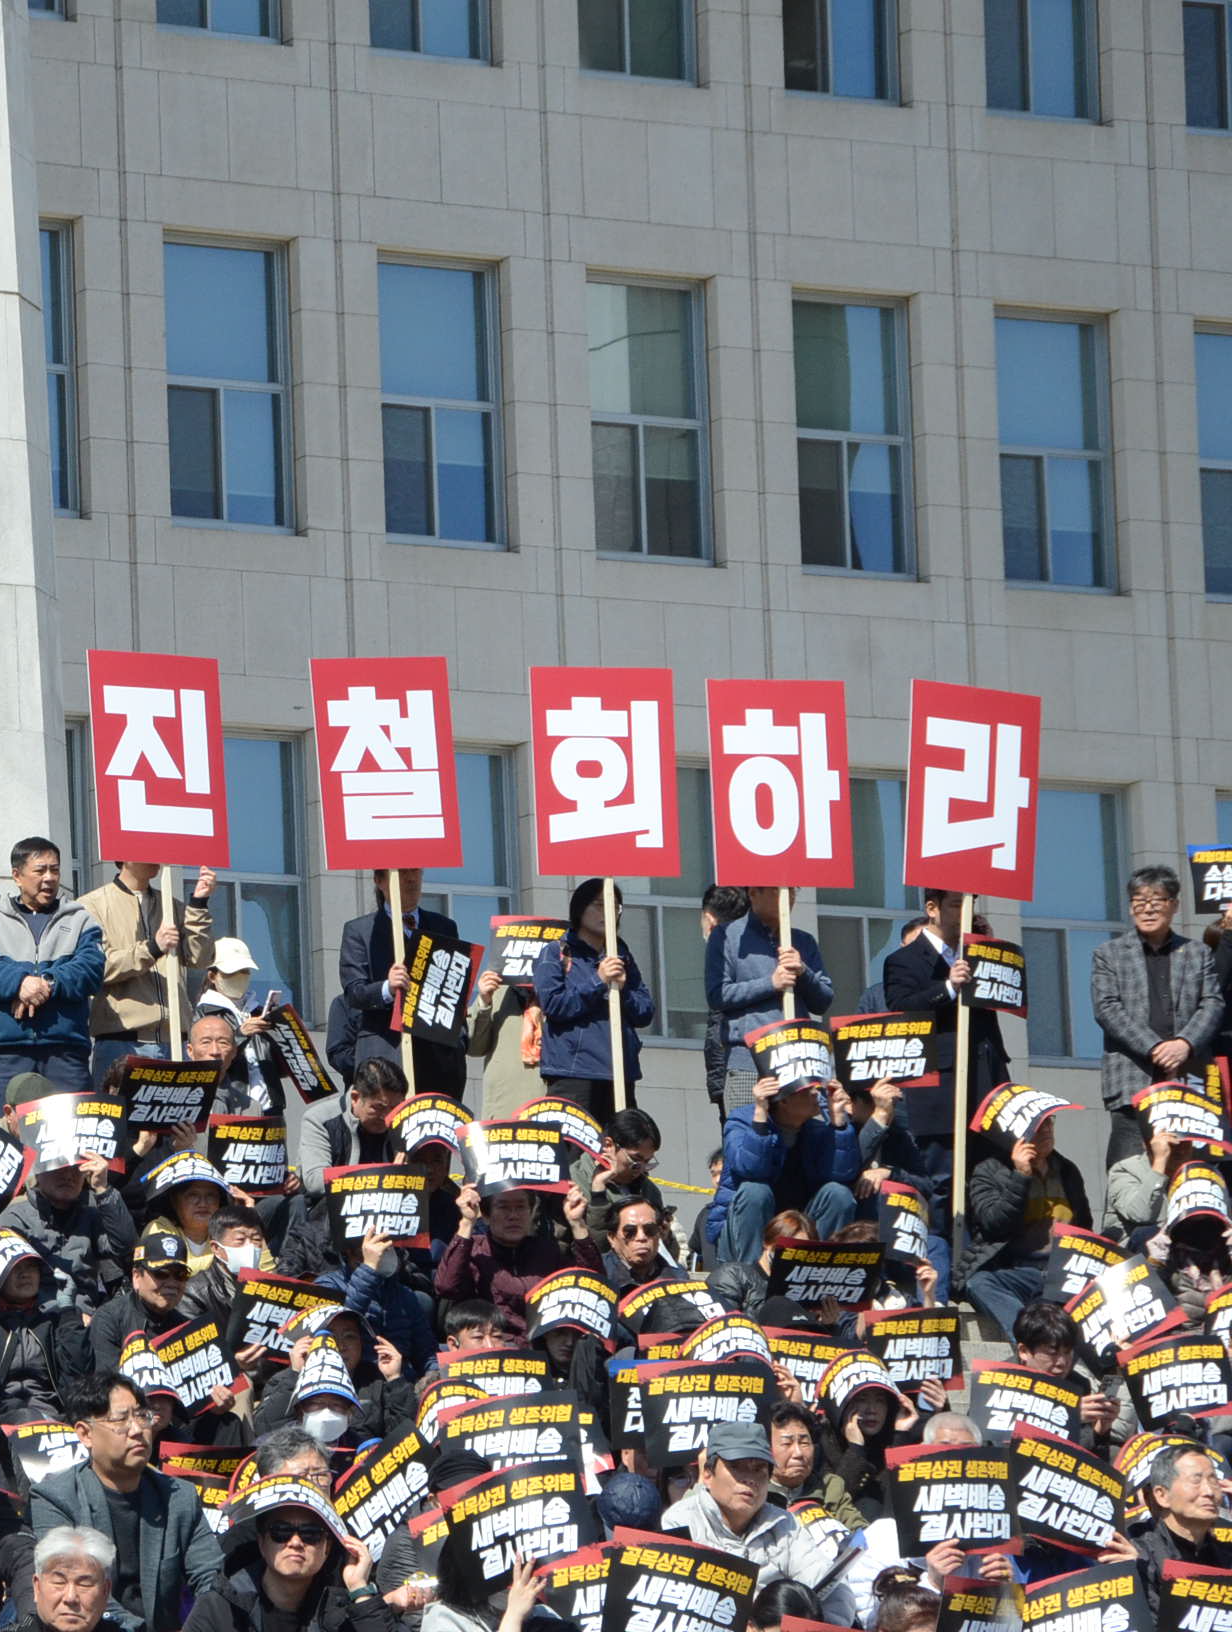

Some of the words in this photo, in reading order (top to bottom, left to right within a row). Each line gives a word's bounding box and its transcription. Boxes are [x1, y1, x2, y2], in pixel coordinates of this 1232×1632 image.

[103, 684, 214, 836] 진
[327, 685, 445, 841] 철
[546, 696, 664, 849] 회
[722, 708, 841, 860] 하
[921, 717, 1031, 871] 라
[417, 949, 450, 1027] 새벽배송
[973, 962, 1021, 987] 새벽배송
[435, 950, 471, 1030] 결사반대
[974, 980, 1022, 1007] 결사반대
[837, 1024, 883, 1039] 골목상권
[884, 1021, 932, 1036] 생존위협
[846, 1039, 924, 1061] 새벽배송
[129, 1067, 175, 1083] 골목상권
[850, 1058, 927, 1081] 결사반대
[132, 1085, 204, 1106] 새벽배송
[76, 1102, 123, 1118] 생존위협
[128, 1105, 201, 1123] 결사반대
[215, 1125, 263, 1140] 골목상권
[516, 1128, 560, 1144] 생존위협
[331, 1177, 380, 1193] 골목상권
[382, 1175, 425, 1190] 생존위협
[484, 1163, 561, 1184] 결사반대
[340, 1193, 418, 1216] 새벽배송
[345, 1215, 420, 1239] 결사반대
[781, 1248, 831, 1264] 골목상권
[1059, 1235, 1106, 1258] 골목상권
[786, 1265, 866, 1285] 새벽배송
[242, 1281, 292, 1303] 골목상권
[538, 1286, 611, 1319] 새벽배송
[184, 1323, 218, 1350] 생존위협
[872, 1320, 919, 1336] 골목상권
[884, 1337, 950, 1359] 새벽배송
[448, 1360, 499, 1376] 골목상권
[503, 1358, 545, 1375] 생존위협
[888, 1358, 953, 1381] 결사반대
[1127, 1349, 1175, 1376] 골목상권
[177, 1362, 234, 1408] 결사반대
[648, 1375, 711, 1395] 골목상권
[714, 1375, 765, 1394] 생존위협
[978, 1371, 1033, 1389] 골목상권
[1034, 1380, 1080, 1408] 생존위협
[1142, 1362, 1222, 1397] 새벽배송
[447, 1410, 504, 1438] 골목상권
[509, 1404, 573, 1425] 생존위협
[663, 1396, 758, 1424] 새벽배송
[986, 1390, 1069, 1427] 새벽배송
[370, 1434, 420, 1482] 생존위협
[1016, 1439, 1075, 1473] 골목상권
[897, 1460, 962, 1483] 골목상권
[965, 1460, 1008, 1480] 생존위협
[451, 1492, 505, 1523] 골목상권
[510, 1473, 575, 1500] 생존위협
[913, 1484, 1006, 1513] 새벽배송
[1020, 1466, 1115, 1521] 새벽배송
[471, 1497, 570, 1551] 새벽배송
[919, 1513, 1011, 1542] 결사반대
[1017, 1493, 1116, 1549] 결사반대
[480, 1524, 578, 1579] 결사반대
[620, 1546, 695, 1576] 골목상권
[695, 1561, 753, 1596] 생존위협
[626, 1575, 737, 1625] 새벽배송
[1066, 1575, 1135, 1609] 생존위협
